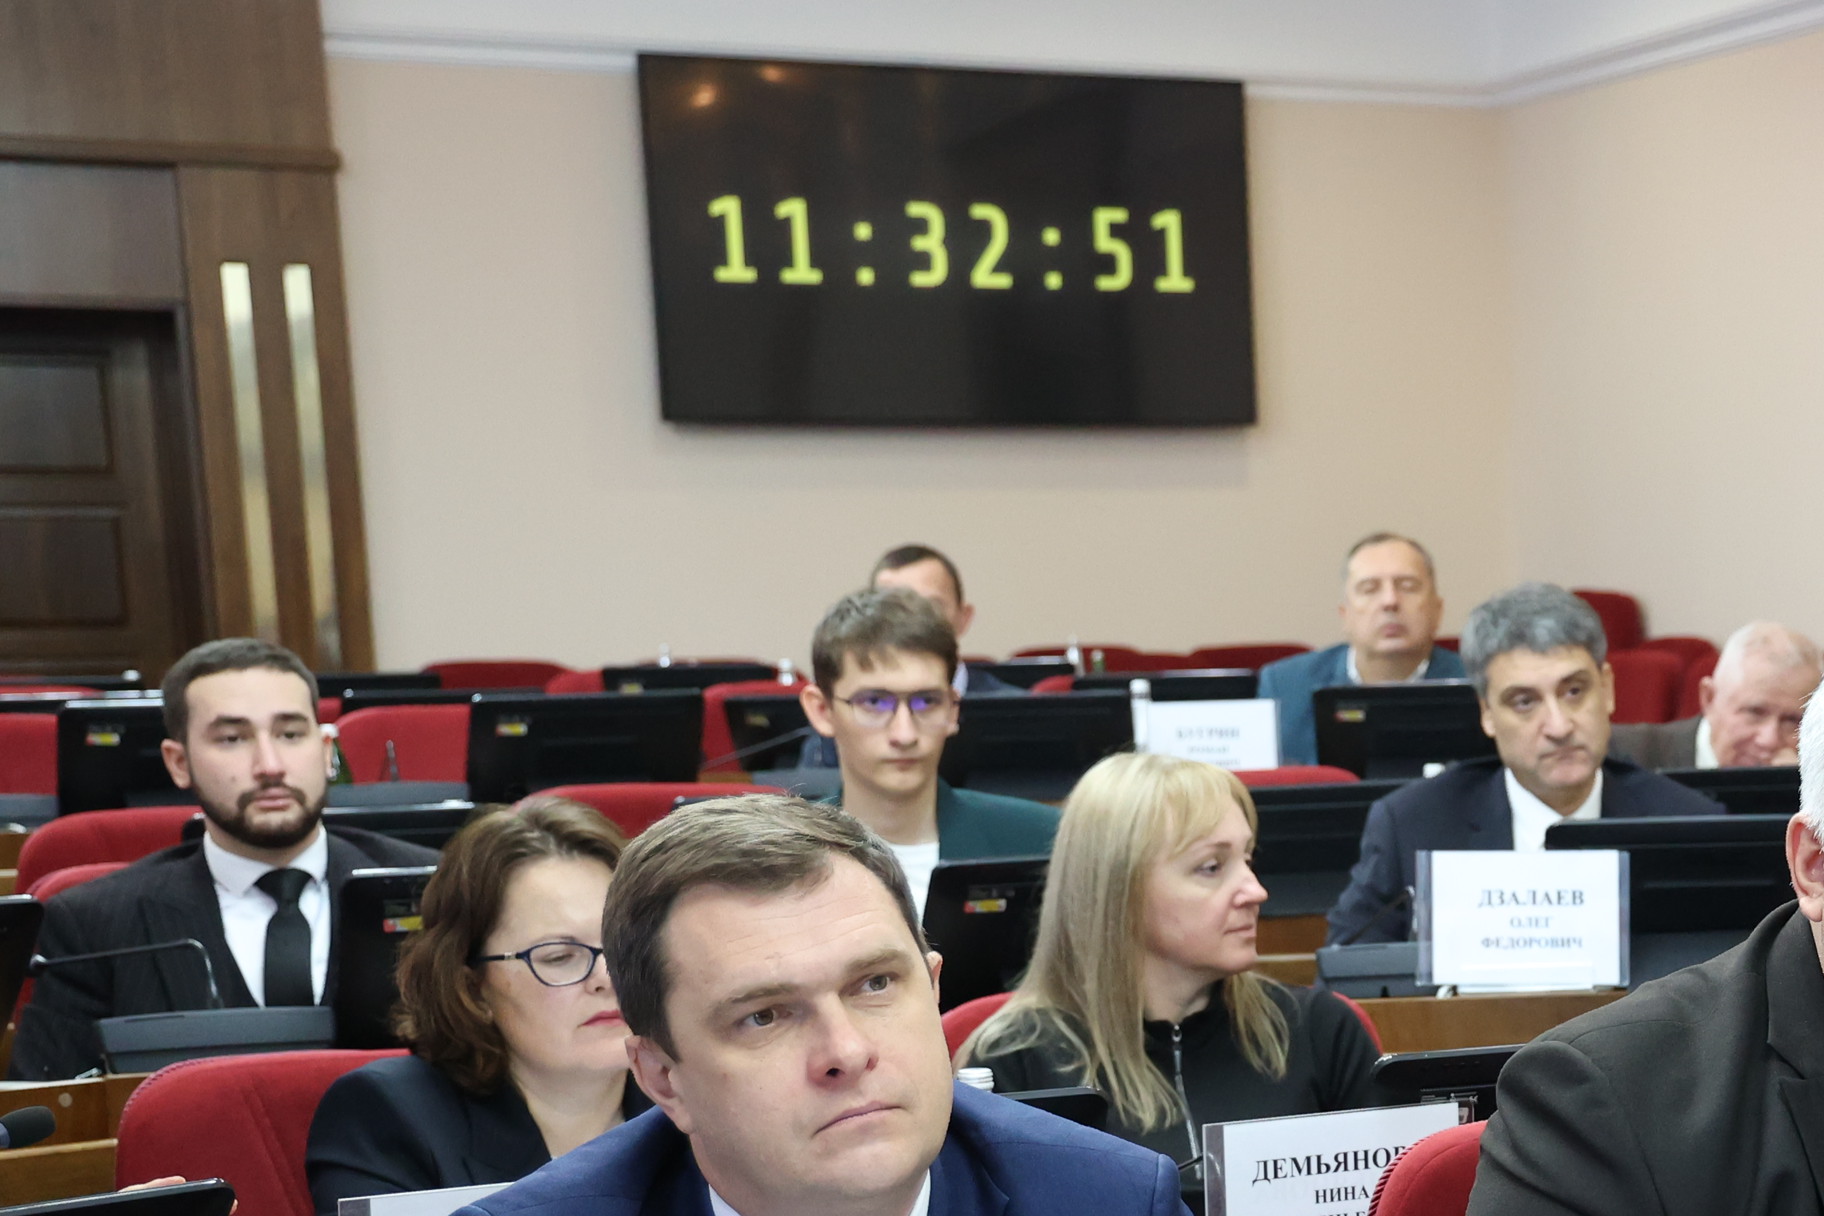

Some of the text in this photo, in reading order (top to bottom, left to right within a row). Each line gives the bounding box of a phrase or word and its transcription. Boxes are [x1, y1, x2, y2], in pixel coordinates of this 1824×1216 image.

[707, 194, 1196, 294] 11:32:51
[1478, 889, 1586, 909] ДЗАЛАЕВ
[1510, 915, 1552, 929] ОЛЕГ
[1481, 936, 1583, 951] ФЕДОРОВИЧ
[1314, 1184, 1370, 1205] НИНА
